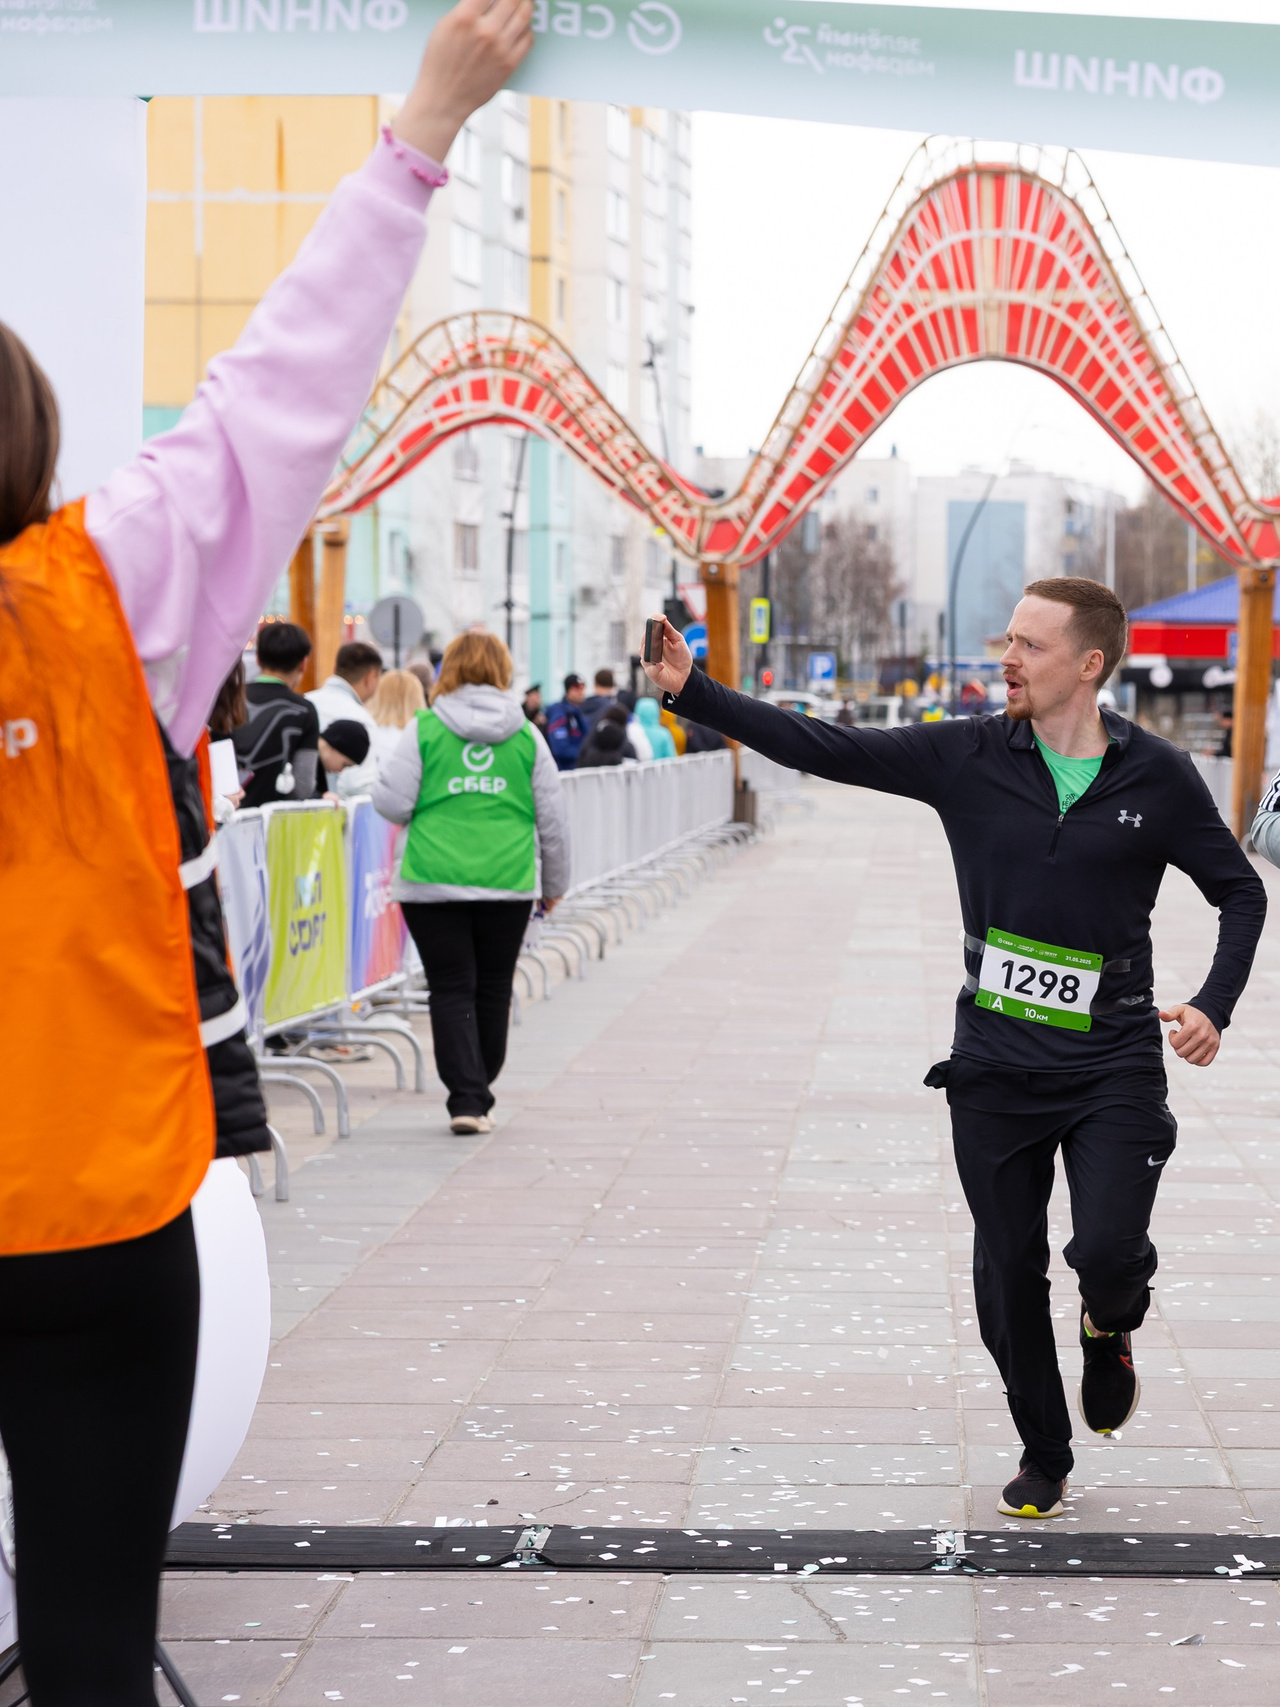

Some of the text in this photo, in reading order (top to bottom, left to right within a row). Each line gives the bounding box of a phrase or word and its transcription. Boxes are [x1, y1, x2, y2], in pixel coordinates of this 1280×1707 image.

[448, 776, 507, 794] СБЕР
[1065, 955, 1092, 965] 31.05.2025
[1001, 959, 1081, 1004] 1298
